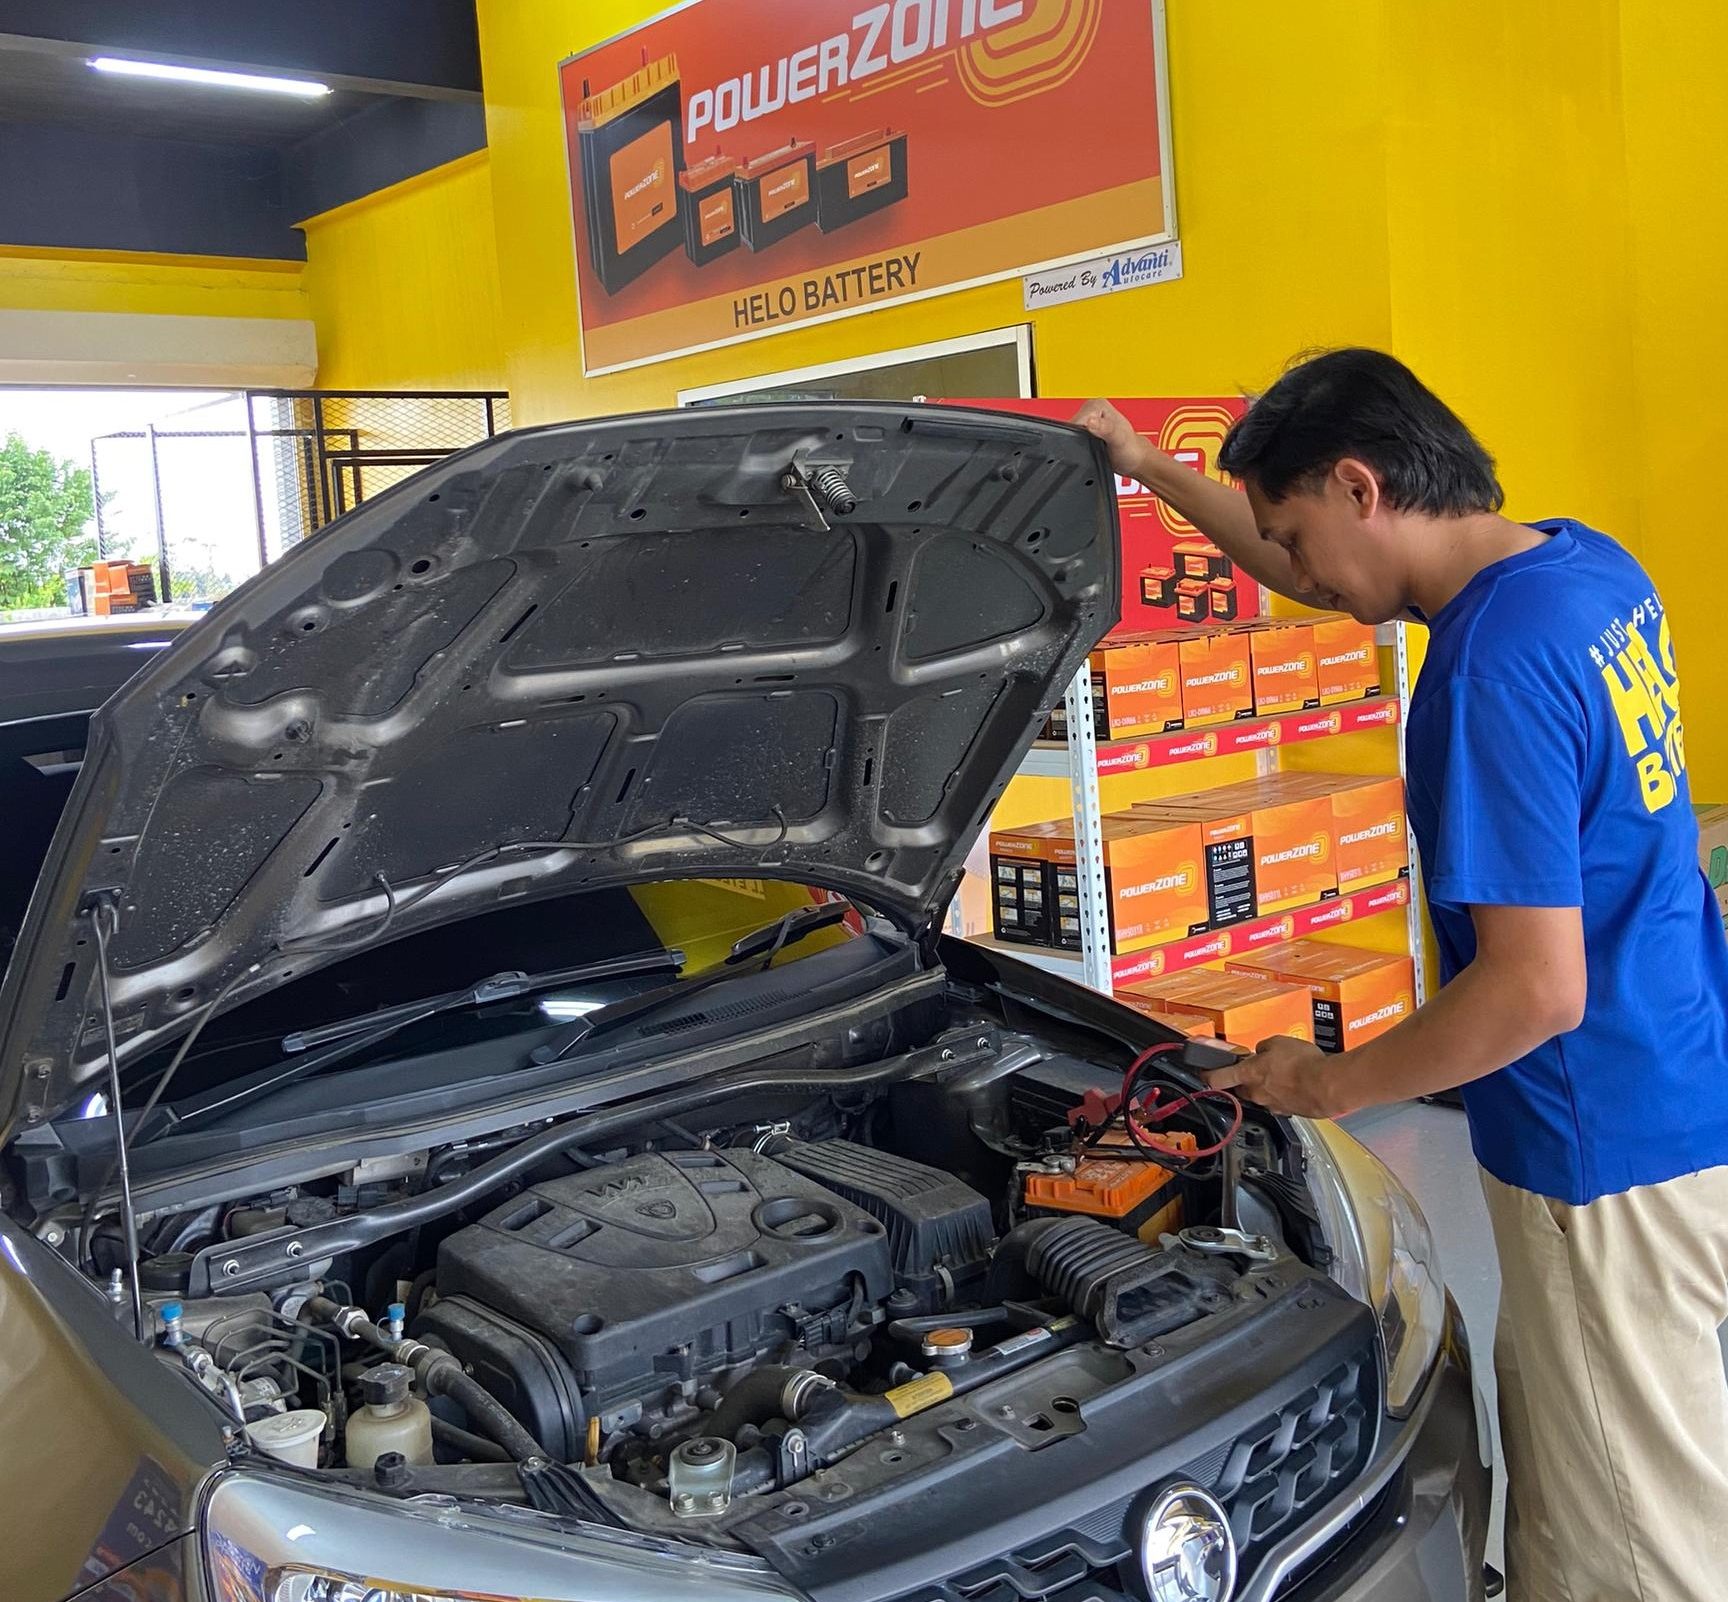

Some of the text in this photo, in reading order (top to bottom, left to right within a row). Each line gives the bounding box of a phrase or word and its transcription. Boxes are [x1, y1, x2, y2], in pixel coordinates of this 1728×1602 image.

[1029, 249, 1169, 299] Powered By Advanti
[733, 252, 921, 328] HELO BATTERY
[1320, 649, 1368, 667] POWERZONE
[1257, 660, 1306, 676] POWERZONE
[1111, 678, 1168, 696] POWERZONE
[1186, 669, 1238, 688] POWERZONE
[1169, 741, 1211, 756] POWERZONE
[1097, 752, 1142, 768] POWERZONE
[1340, 822, 1397, 846] POWERZONE
[1260, 843, 1320, 866] POWERZONE
[1120, 873, 1187, 899] POWERZONE
[1184, 942, 1226, 960] POWERZONE
[1113, 960, 1158, 979] POWERZONE
[1348, 1001, 1404, 1031] POWERZONE
